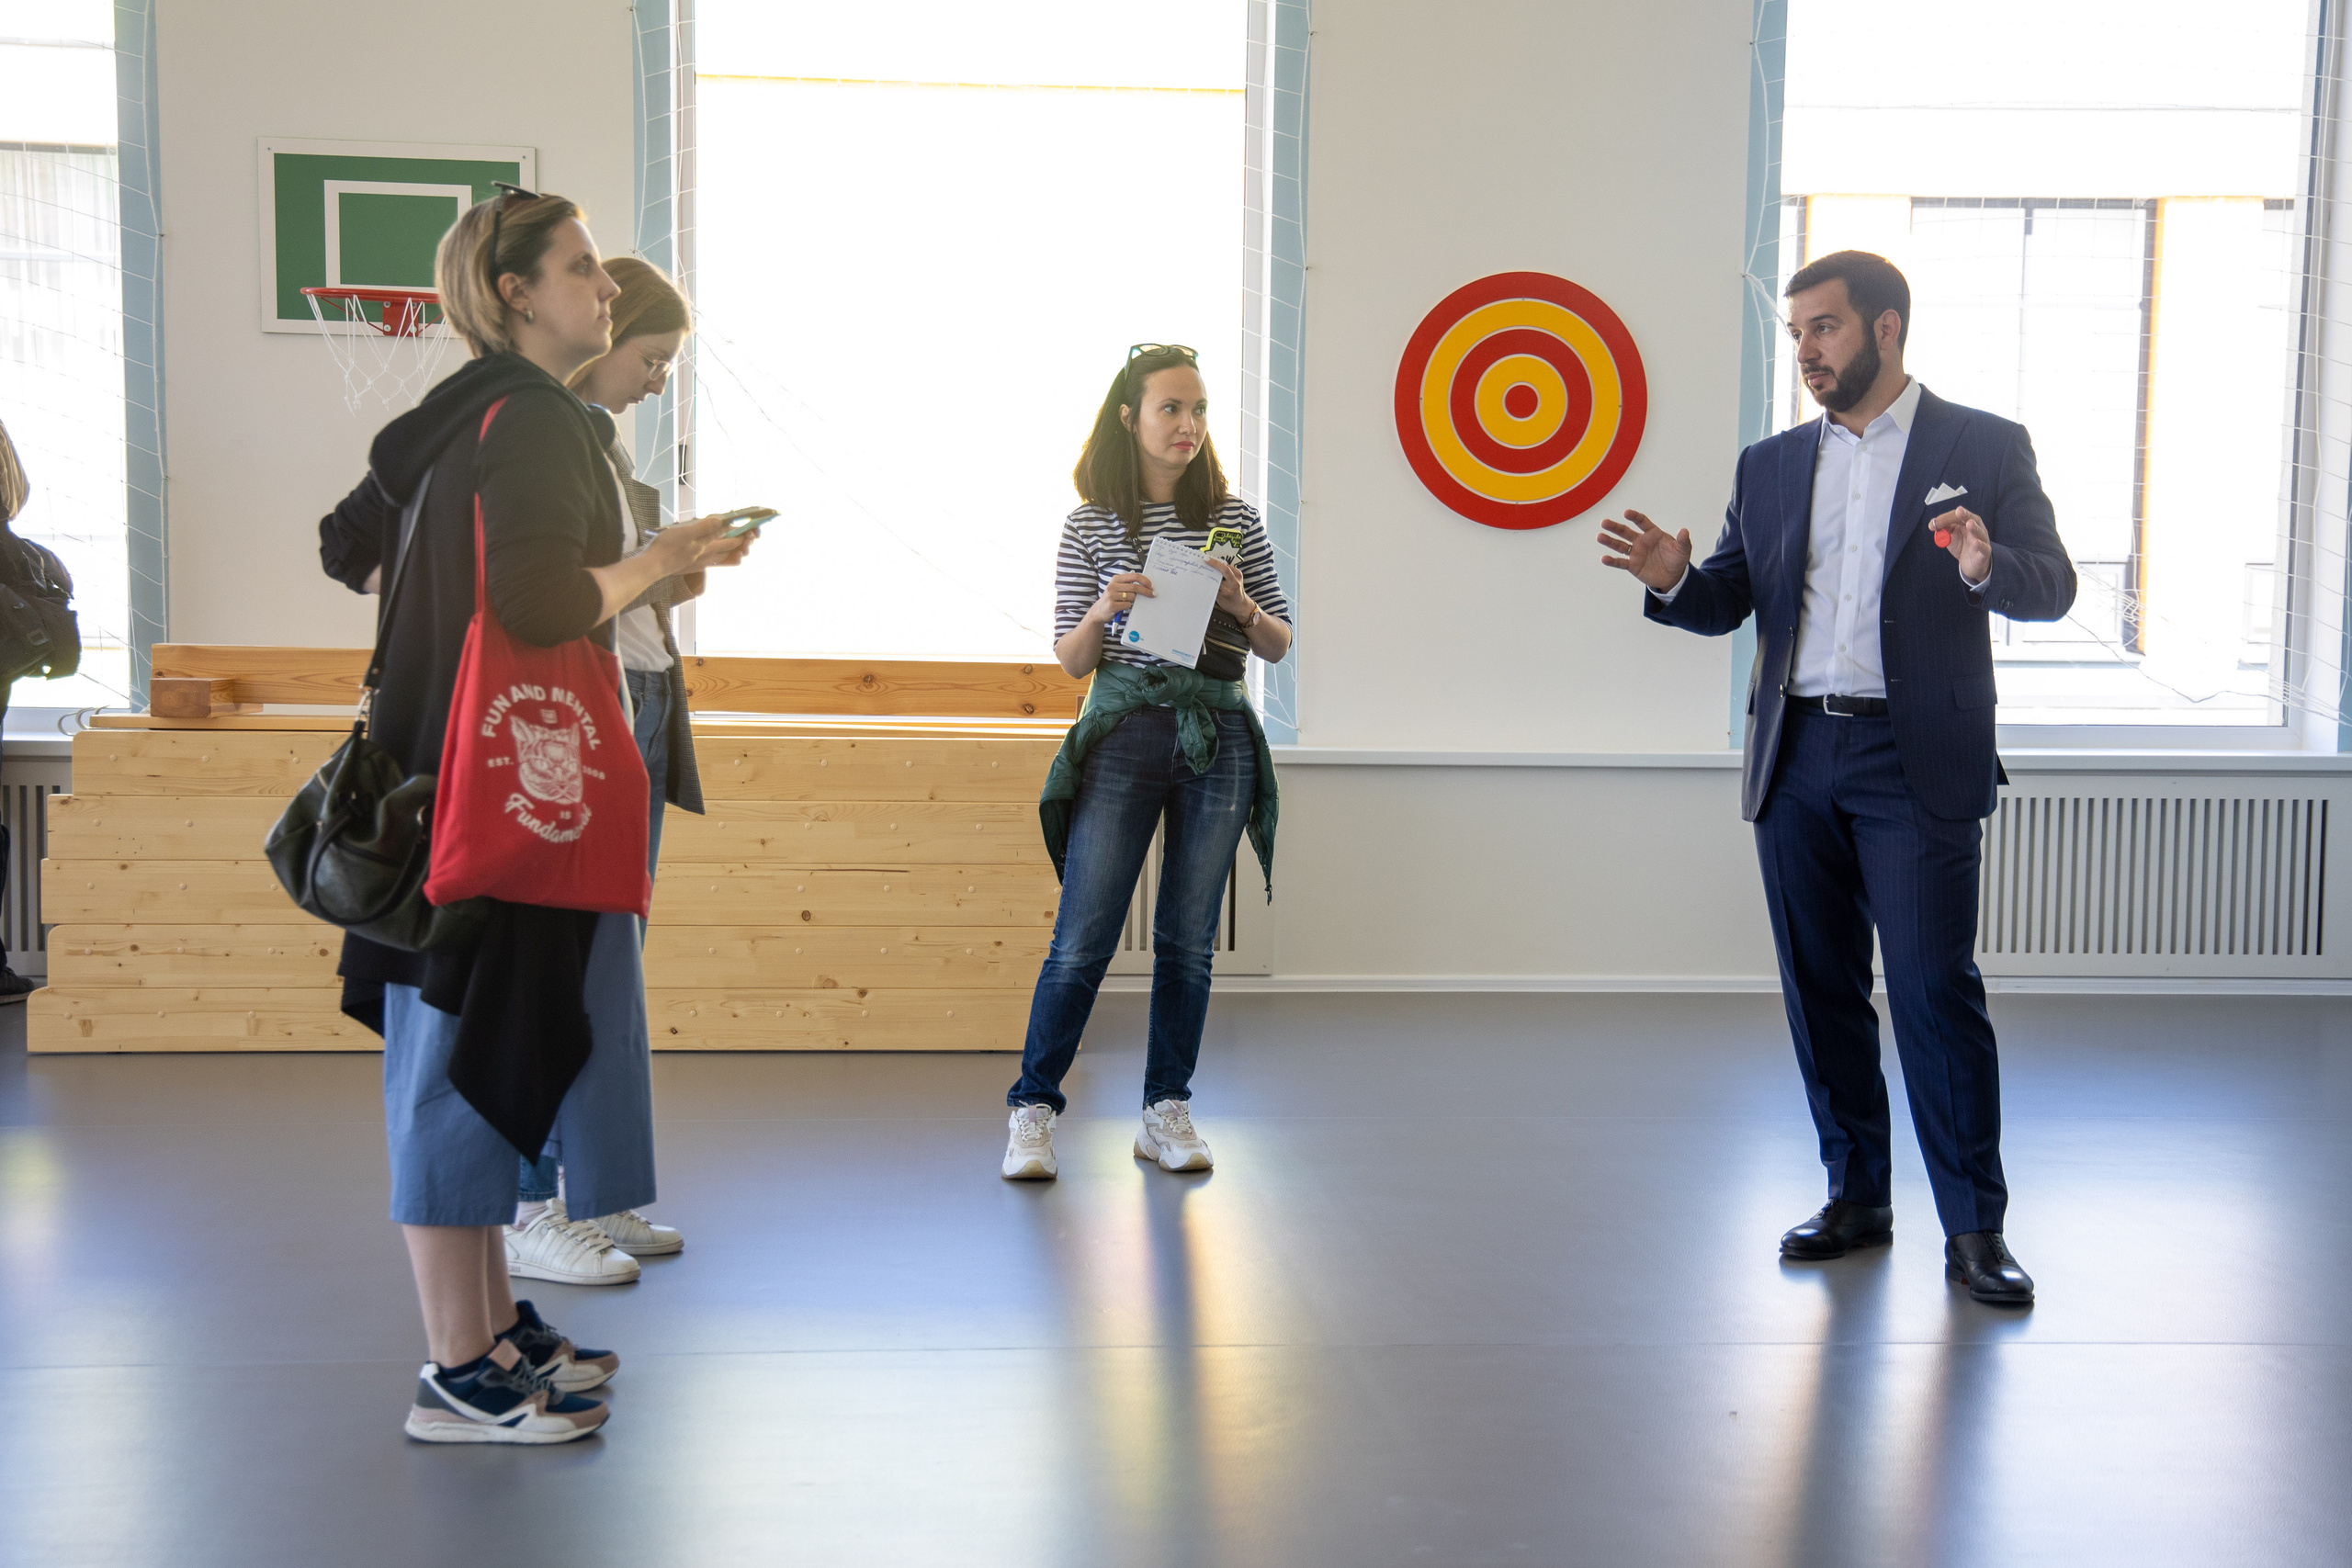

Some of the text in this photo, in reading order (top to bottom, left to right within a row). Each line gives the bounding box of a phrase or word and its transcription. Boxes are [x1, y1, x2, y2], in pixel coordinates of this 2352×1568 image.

[481, 694, 512, 739] FUN
[510, 682, 547, 704] AND
[487, 756, 514, 768] EST.
